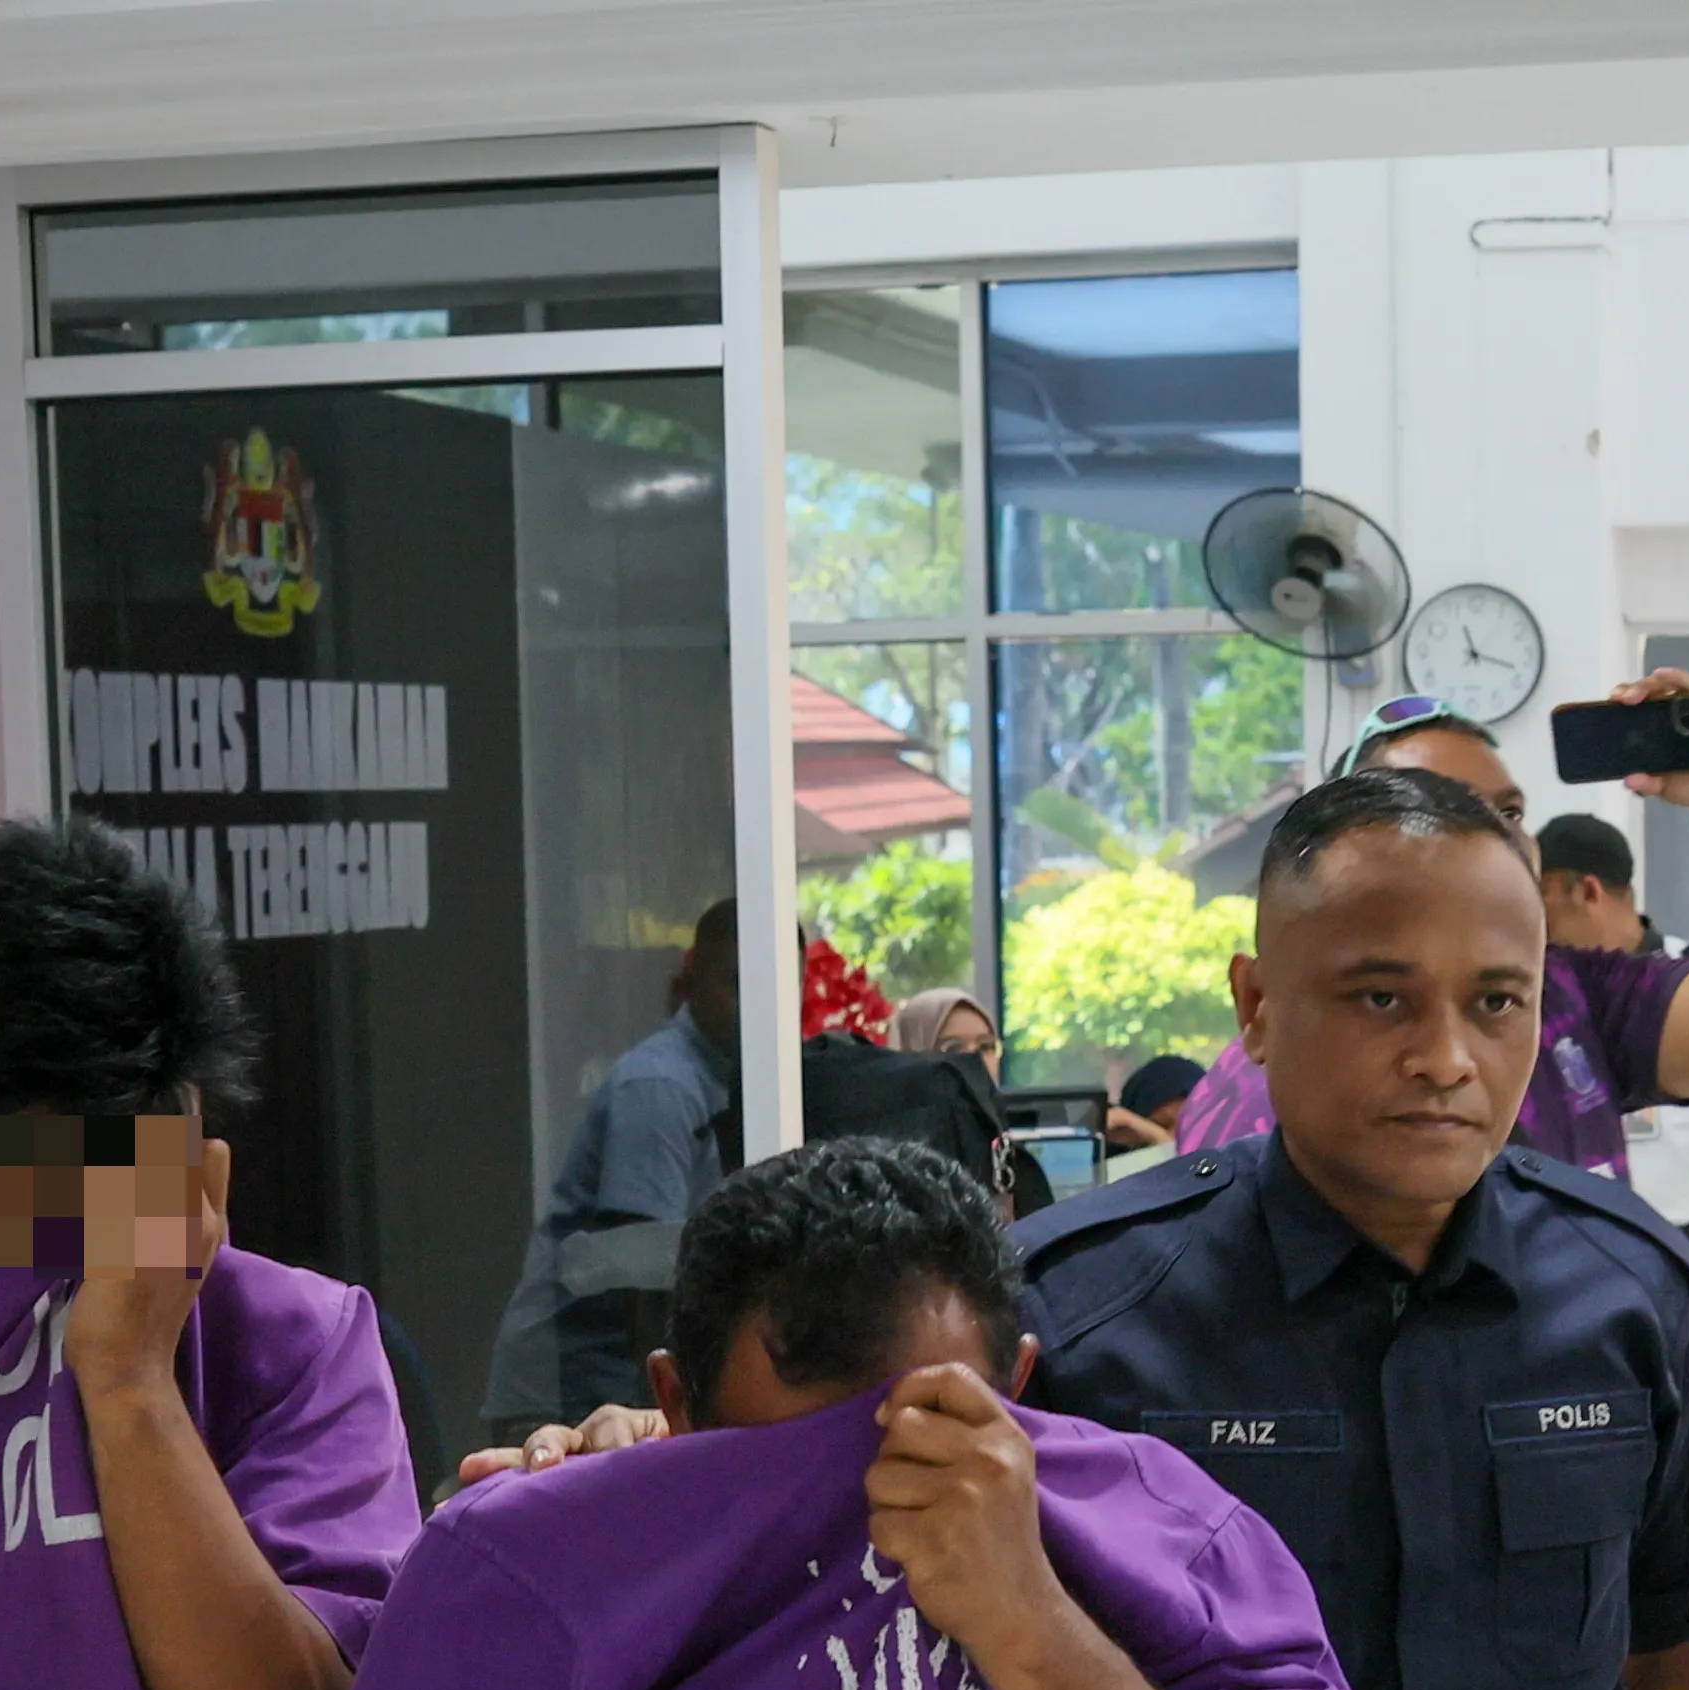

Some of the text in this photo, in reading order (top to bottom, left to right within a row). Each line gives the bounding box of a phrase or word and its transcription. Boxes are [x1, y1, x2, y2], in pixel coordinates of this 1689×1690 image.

[65, 668, 449, 793] OMPLEKS MAHKAMAH
[227, 820, 429, 939] TERENGGANU
[1210, 1419, 1276, 1446] FAIZ
[1538, 1402, 1611, 1433] POLIS
